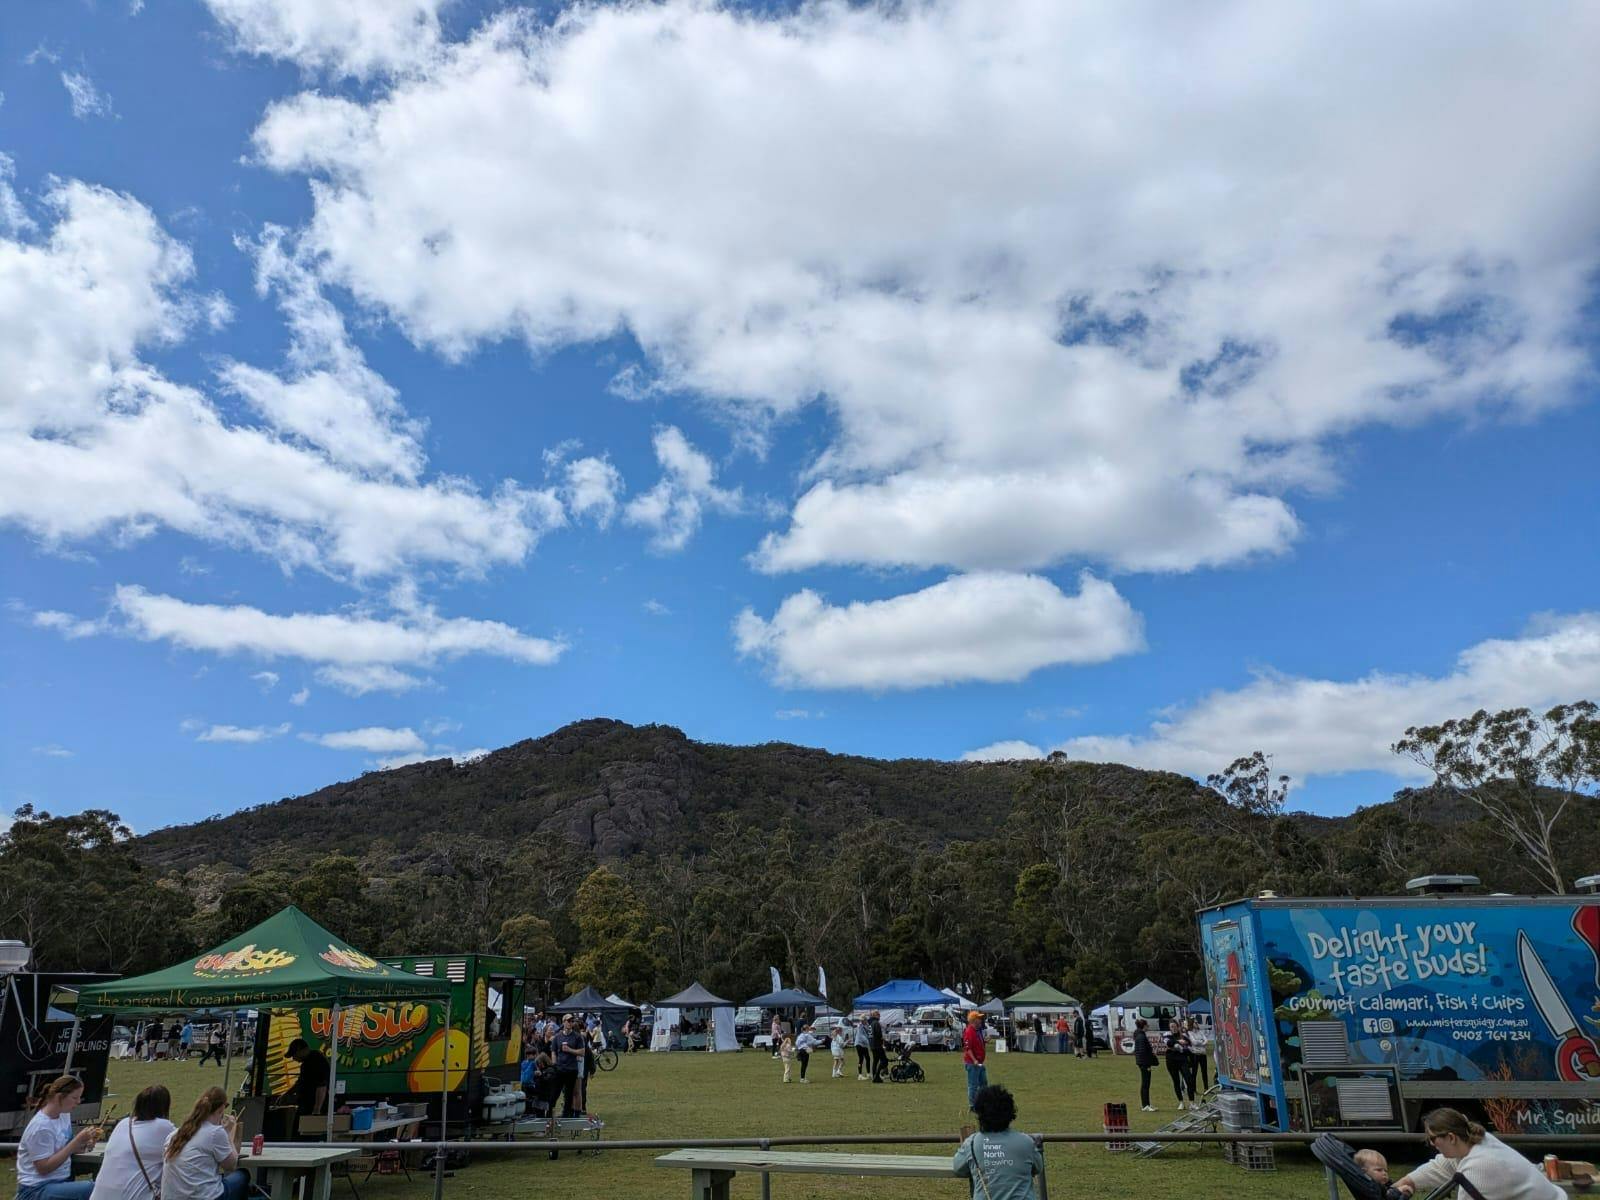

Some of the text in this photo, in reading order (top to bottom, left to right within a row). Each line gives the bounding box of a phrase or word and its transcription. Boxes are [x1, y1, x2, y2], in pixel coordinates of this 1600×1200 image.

[1308, 921, 1476, 963] Delight your
[1329, 943, 1487, 995] taste buds!
[98, 991, 119, 1008] the
[122, 989, 173, 1008] original
[234, 991, 265, 1005] twist
[269, 988, 319, 1003] potato
[1289, 995, 1355, 1015] Gourmet
[1359, 993, 1434, 1013] Calamari,
[1482, 995, 1525, 1014] Chips
[58, 1027, 82, 1039] JES
[1452, 1030, 1531, 1041] 0408 764 234
[1517, 1109, 1546, 1125] Mr.
